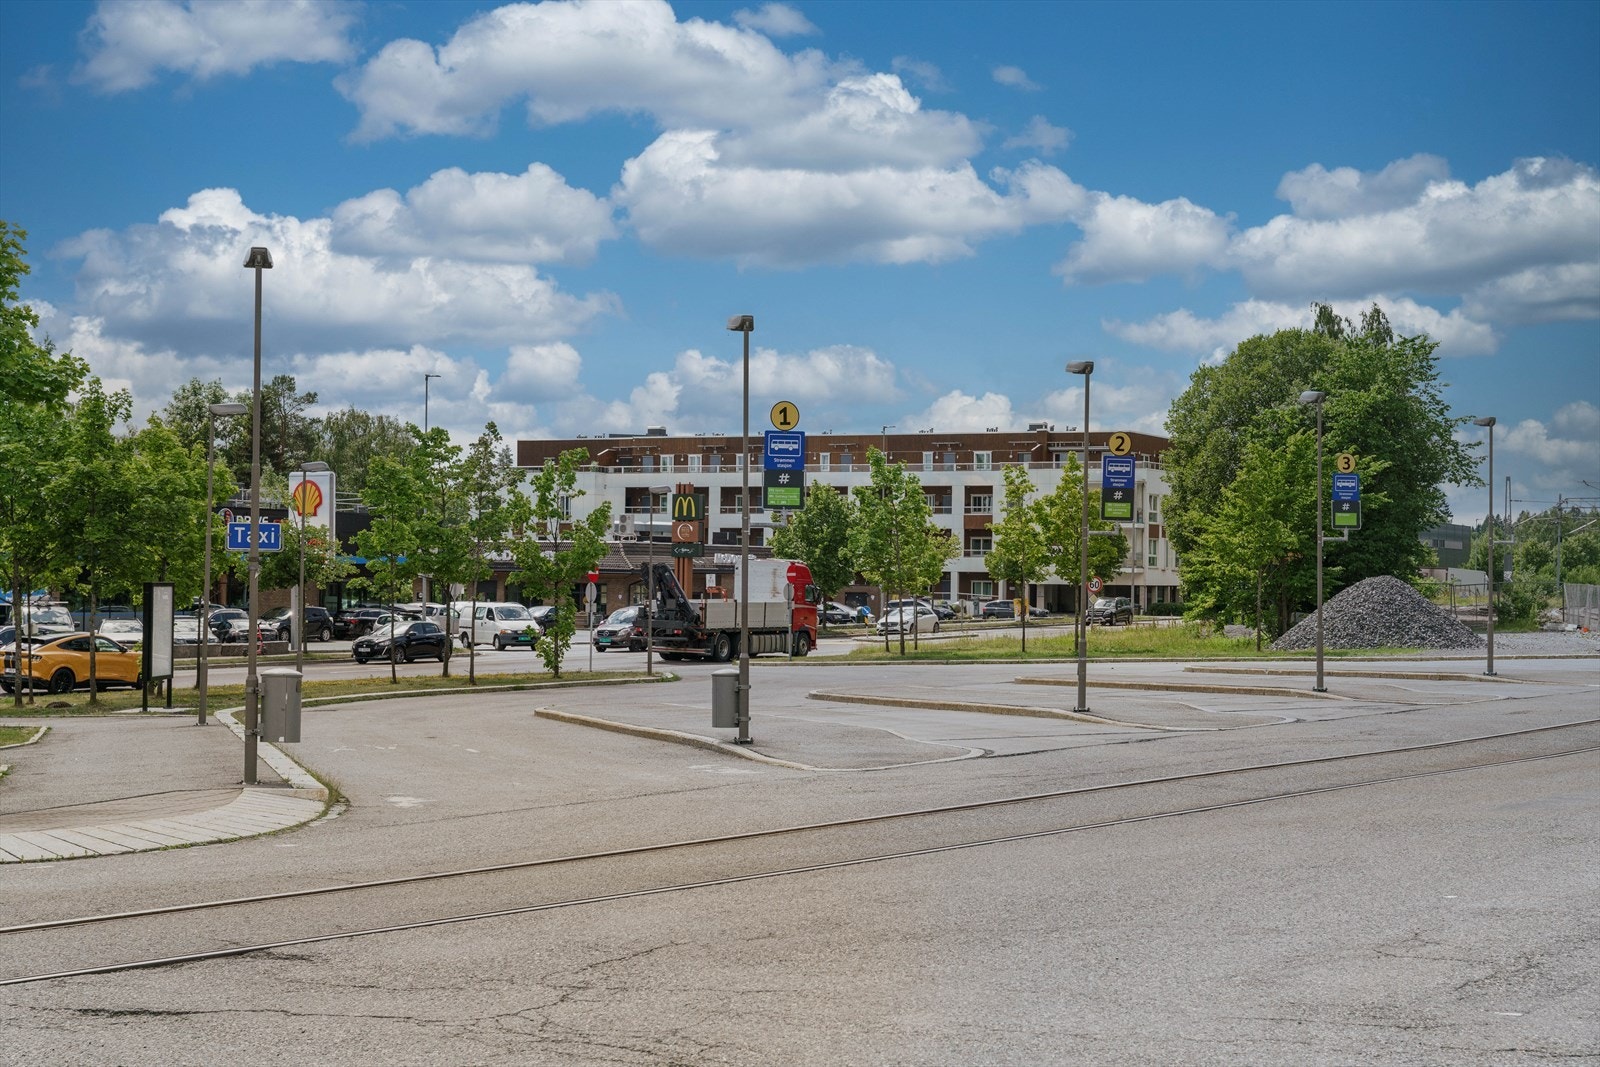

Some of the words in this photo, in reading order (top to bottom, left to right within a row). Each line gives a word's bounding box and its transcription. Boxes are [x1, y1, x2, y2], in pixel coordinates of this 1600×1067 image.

[779, 406, 791, 426] 1
[1114, 436, 1125, 452] 2
[1342, 457, 1351, 470] 3
